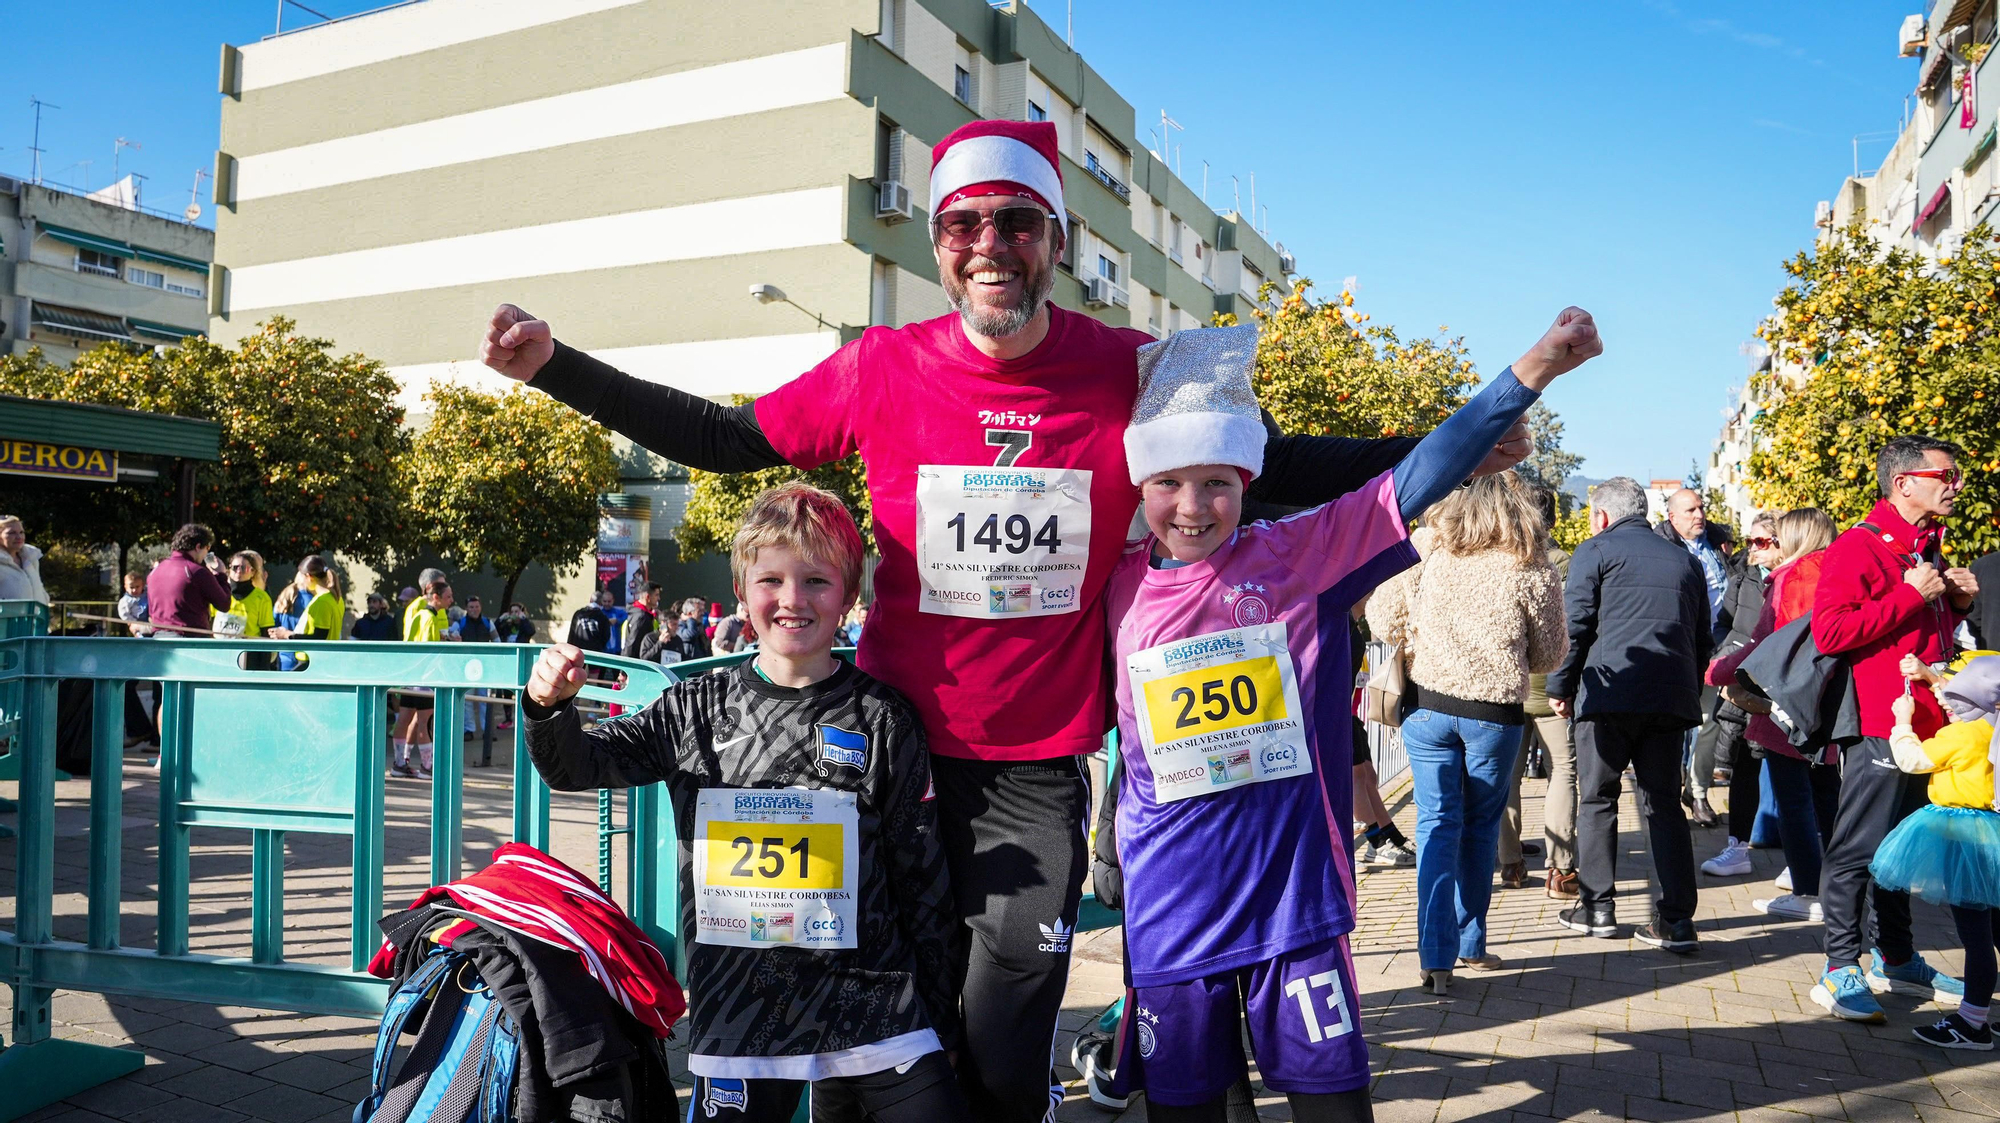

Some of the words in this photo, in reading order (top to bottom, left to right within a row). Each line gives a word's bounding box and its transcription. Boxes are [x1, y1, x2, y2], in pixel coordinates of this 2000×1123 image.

[978, 410, 1041, 426] ウルトラマン
[985, 428, 1032, 467] 7
[964, 479, 1046, 487] populares
[948, 512, 1061, 554] 1494
[946, 563, 964, 571] SAN
[966, 564, 1021, 573] SILVESTRE
[1024, 563, 1081, 573] CORDOBESA
[939, 591, 982, 602] IMDECO
[1048, 588, 1069, 598] GCC
[1164, 638, 1230, 656] carreras
[1165, 640, 1244, 664] populares
[1166, 656, 1203, 668] Diputación
[1216, 648, 1246, 657] Córdoba
[1171, 675, 1258, 729] 250
[1166, 742, 1183, 753] SAN
[1185, 730, 1239, 748] SILVESTRE
[1242, 720, 1297, 737] CORDOBESA
[1201, 744, 1228, 754] MILENA
[1229, 739, 1251, 748] SIMON
[825, 746, 850, 762] Hertha
[851, 752, 864, 766] BSC
[1267, 750, 1289, 762] GCC
[1164, 767, 1205, 784] IMDECO
[1264, 767, 1279, 775] SPORT
[735, 801, 813, 810] populares
[730, 836, 809, 878] 251
[716, 889, 733, 897] SAN
[735, 890, 787, 899] SILVESTRE
[789, 891, 851, 900] CORDOBESA
[707, 917, 747, 929] IMDECO
[812, 920, 837, 930] GCC
[1038, 942, 1068, 953] adids
[1285, 969, 1354, 1044] 13
[712, 1089, 730, 1102] Hertha
[731, 1093, 743, 1103] BSC
